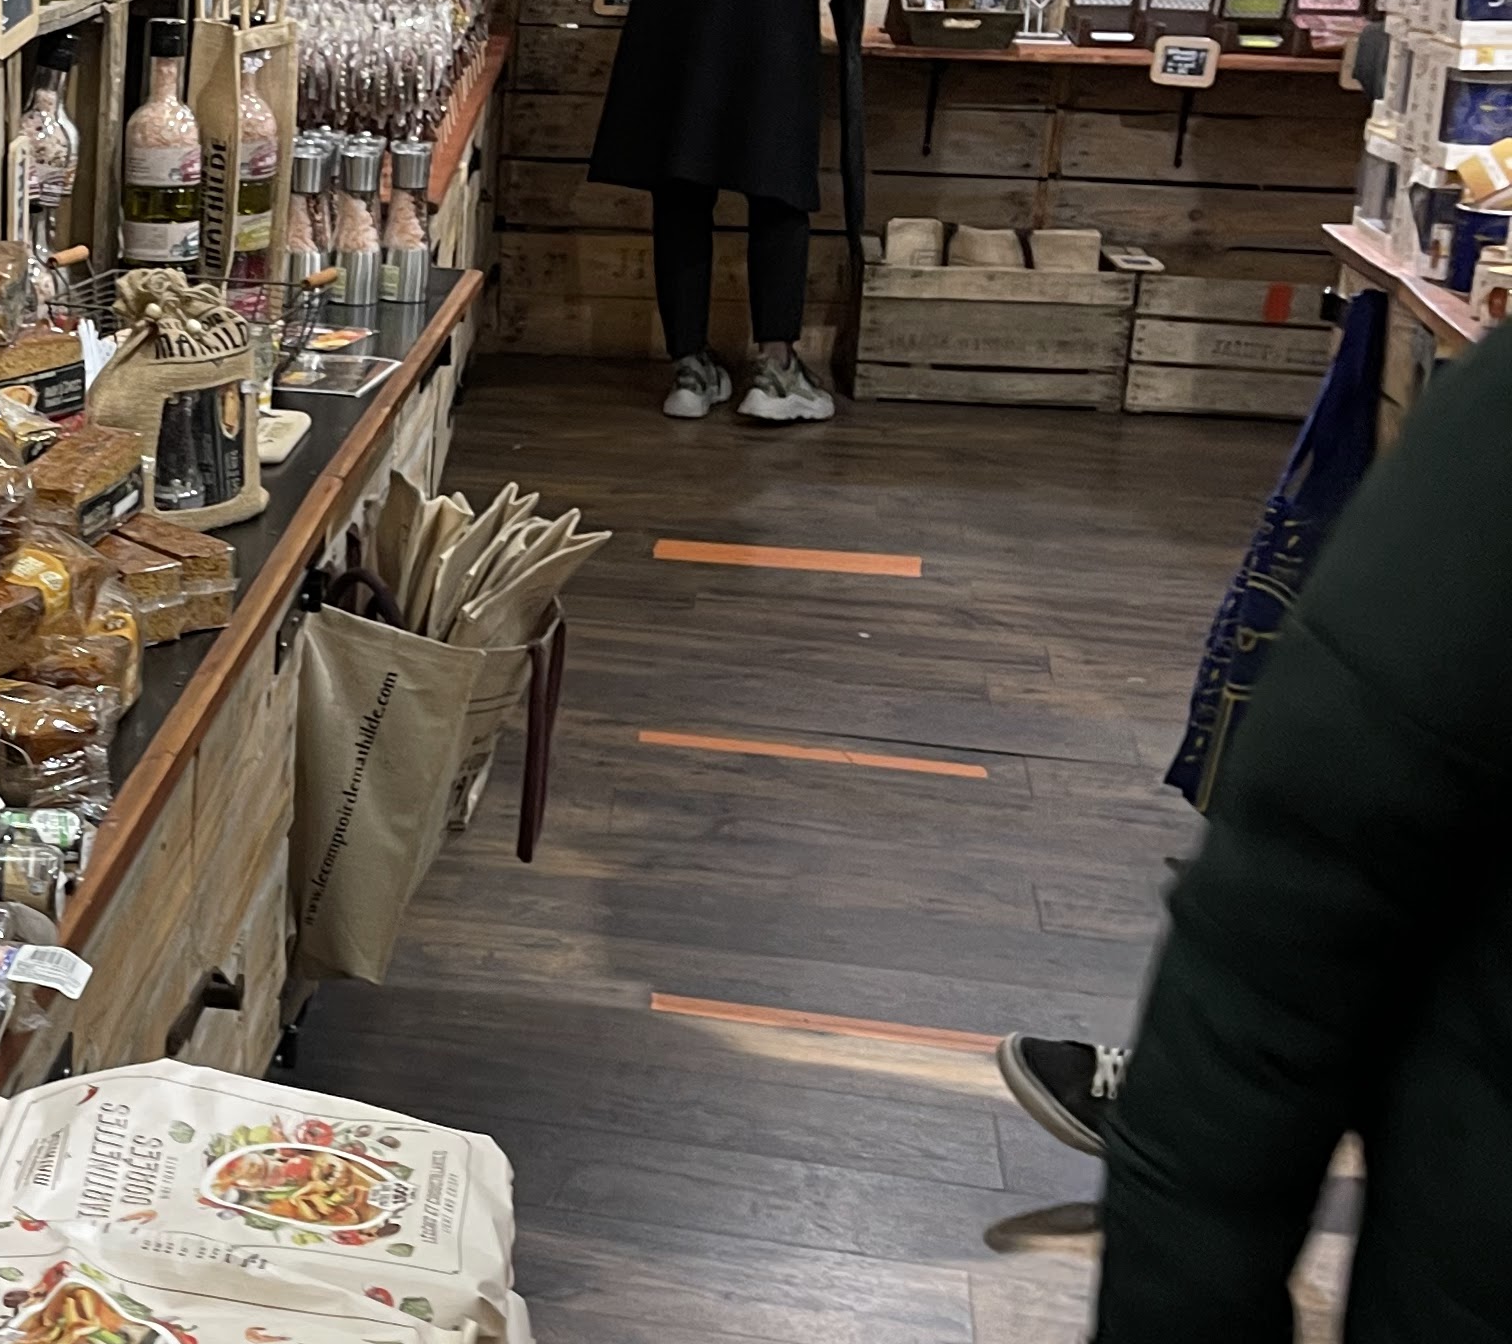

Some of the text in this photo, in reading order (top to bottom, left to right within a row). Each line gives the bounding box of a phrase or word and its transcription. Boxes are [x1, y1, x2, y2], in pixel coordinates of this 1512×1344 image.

[202, 136, 228, 269] MATHILDE
[303, 670, 399, 927] www.lecomptoirdemathilde.com
[76, 1101, 131, 1219] TARTINETTES
